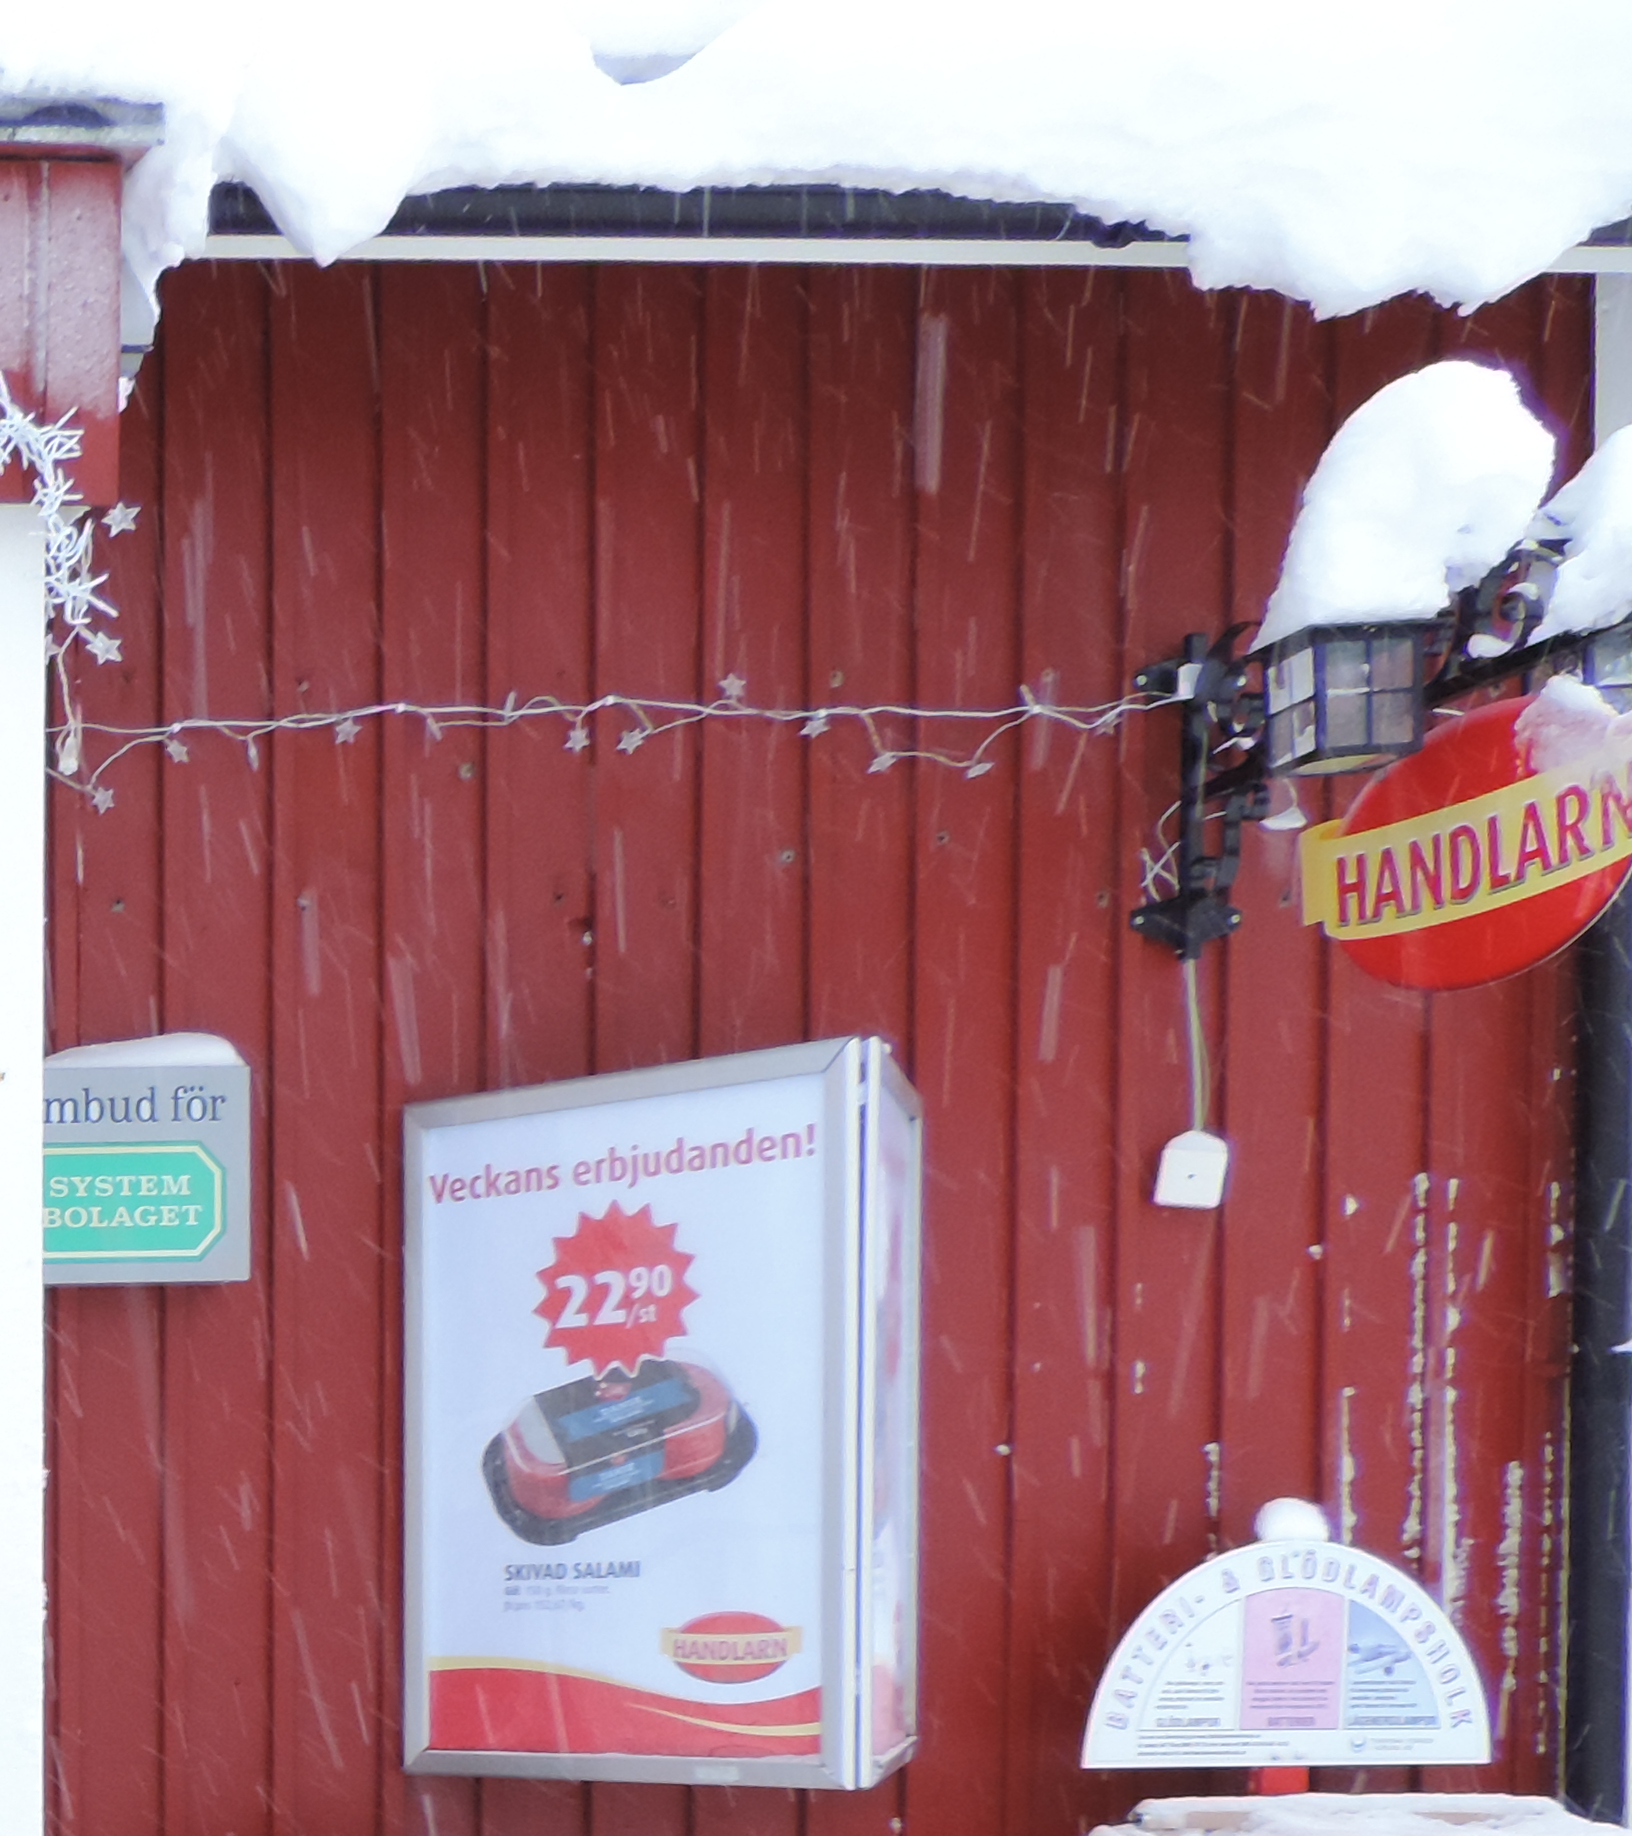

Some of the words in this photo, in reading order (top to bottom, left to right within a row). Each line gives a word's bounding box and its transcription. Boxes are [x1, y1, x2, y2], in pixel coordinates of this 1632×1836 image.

[43, 1086, 159, 1124] mbud
[171, 1085, 227, 1123] för
[429, 1163, 561, 1204] Veckans
[572, 1122, 818, 1189] erbjudanden!
[49, 1174, 191, 1198] SYSTEM
[42, 1204, 204, 1229] BOLAGET
[504, 1563, 568, 1581] SKIVAD
[573, 1560, 641, 1580] SALAMI
[1221, 1567, 1241, 1594] &
